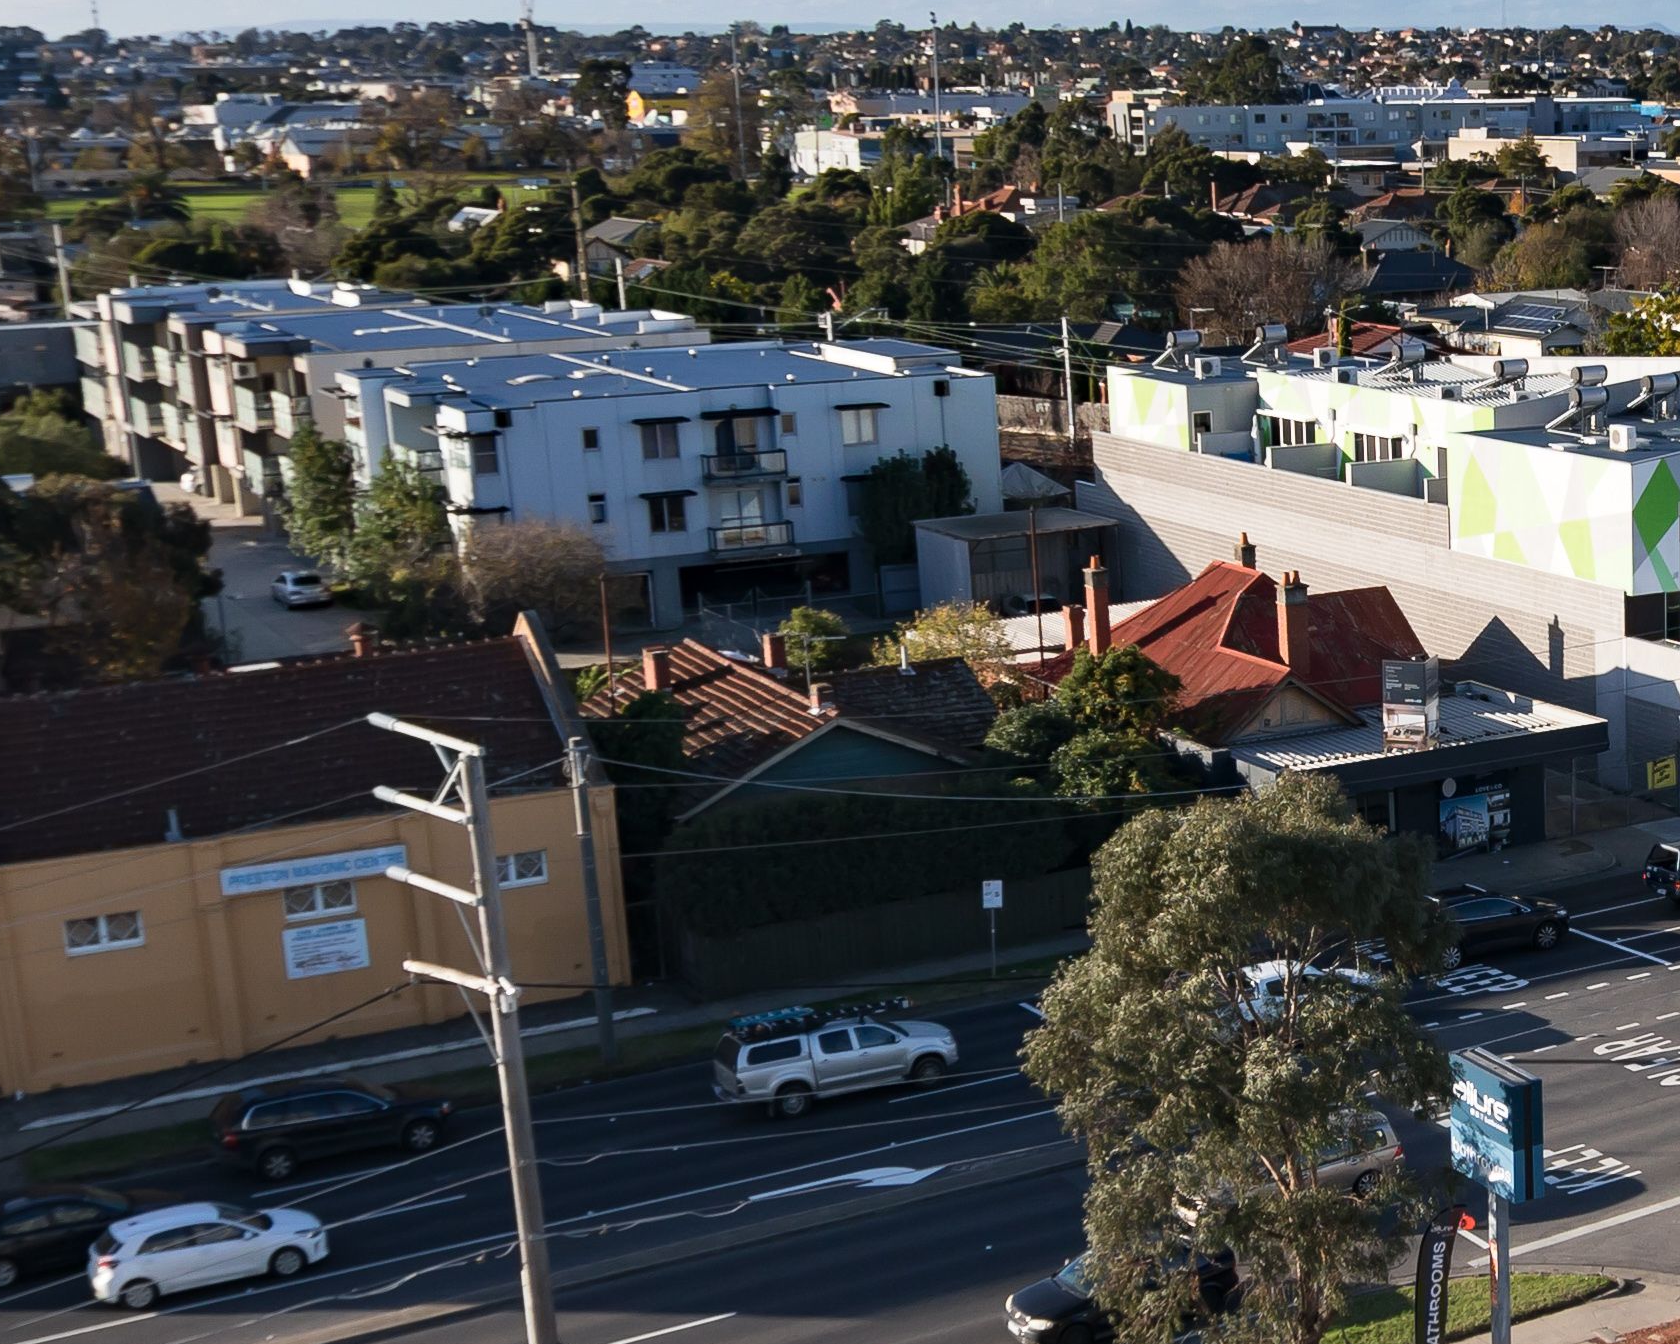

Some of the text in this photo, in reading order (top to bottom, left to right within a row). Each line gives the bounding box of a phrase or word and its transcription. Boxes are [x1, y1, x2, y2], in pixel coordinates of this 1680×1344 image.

[228, 851, 404, 887] PRESTON MASONIC CENTRE
[1452, 1080, 1510, 1122] allure
[1451, 1137, 1513, 1184] bathrooms
